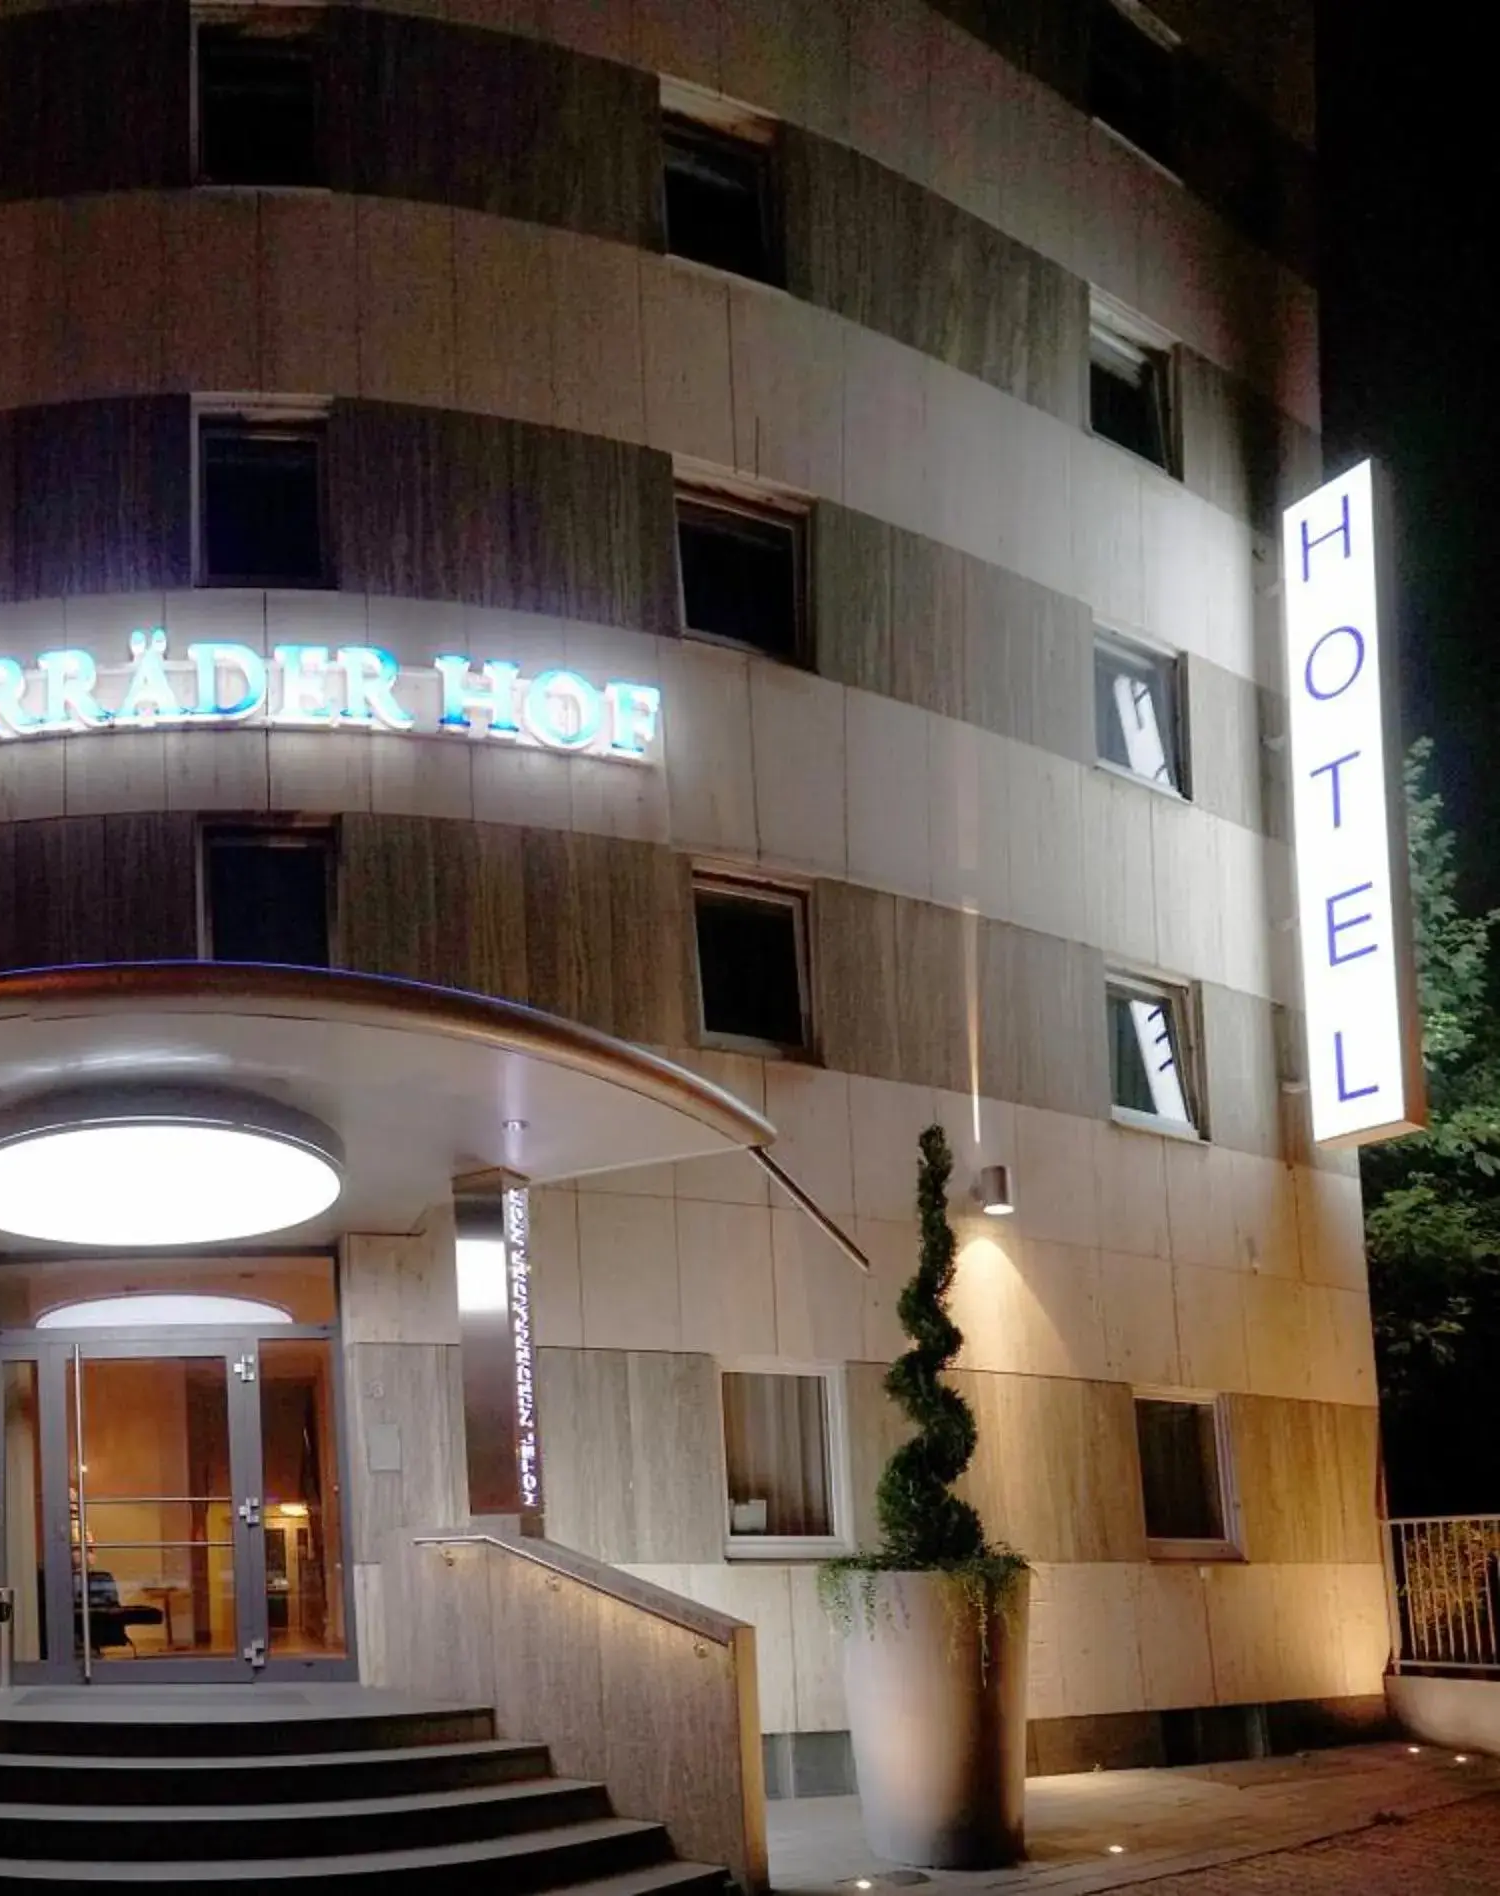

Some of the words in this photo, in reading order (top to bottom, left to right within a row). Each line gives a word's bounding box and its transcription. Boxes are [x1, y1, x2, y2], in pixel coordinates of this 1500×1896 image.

[434, 655, 660, 757] HOF
[1302, 495, 1380, 1103] HOTEL
[520, 1432, 538, 1506] HOTEL
